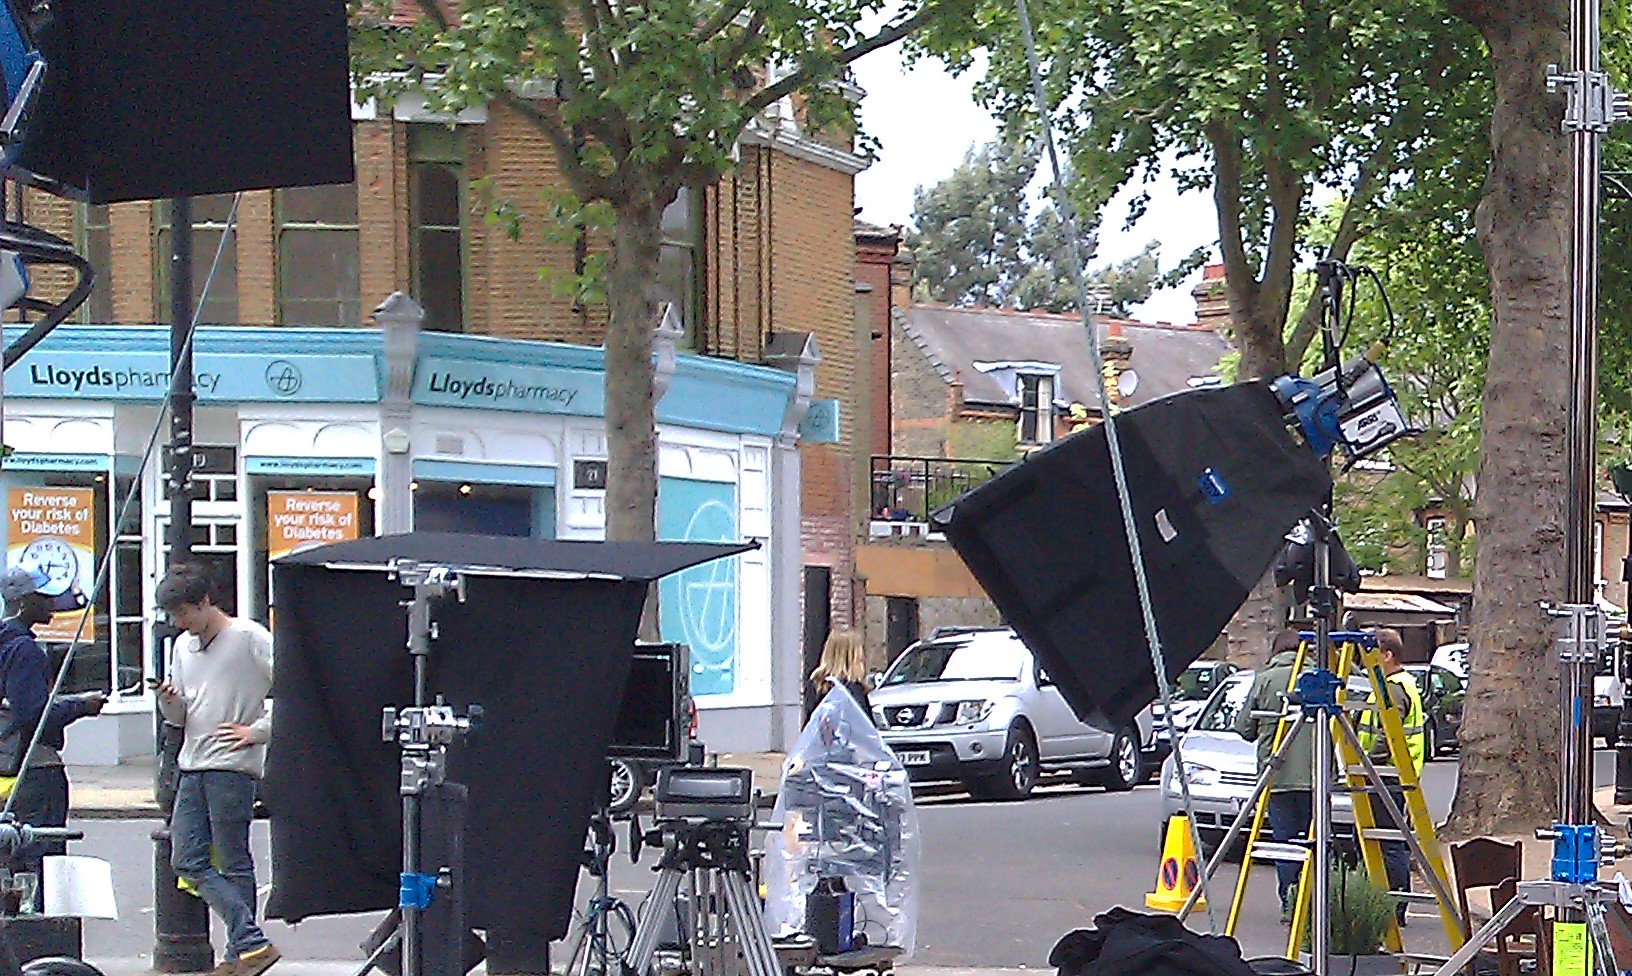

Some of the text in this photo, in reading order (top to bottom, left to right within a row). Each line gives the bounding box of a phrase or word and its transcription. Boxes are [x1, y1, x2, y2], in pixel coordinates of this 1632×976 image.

[30, 364, 221, 393] Lloydspharcy
[429, 372, 578, 407] Lloydspharmacy
[23, 493, 78, 506] Reverse
[285, 498, 341, 511] Reverse
[12, 507, 88, 521] your risk of
[274, 512, 353, 527] your risk of
[21, 521, 80, 534] Diabetes
[283, 526, 344, 539] Diabetes
